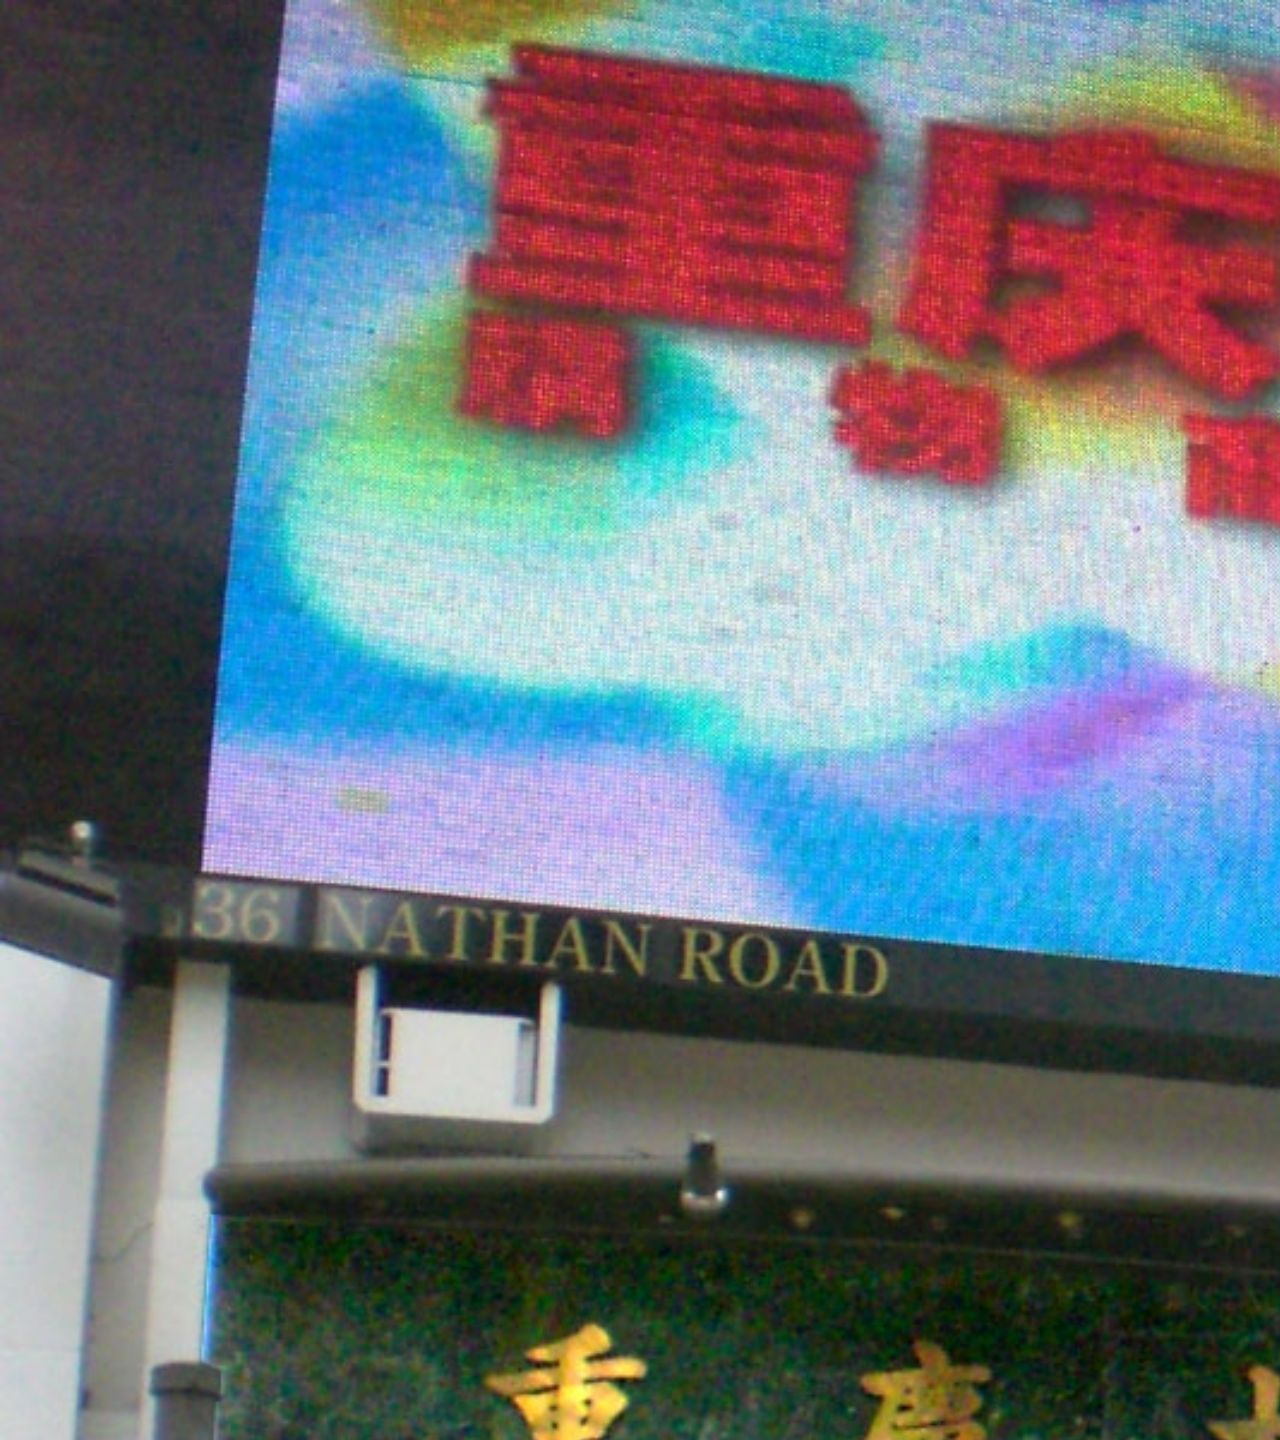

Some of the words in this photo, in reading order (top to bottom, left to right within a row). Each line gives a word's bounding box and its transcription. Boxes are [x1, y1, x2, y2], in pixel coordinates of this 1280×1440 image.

[192, 882, 283, 945] 36
[311, 889, 651, 978] NATHAN
[678, 926, 892, 999] ROAD
